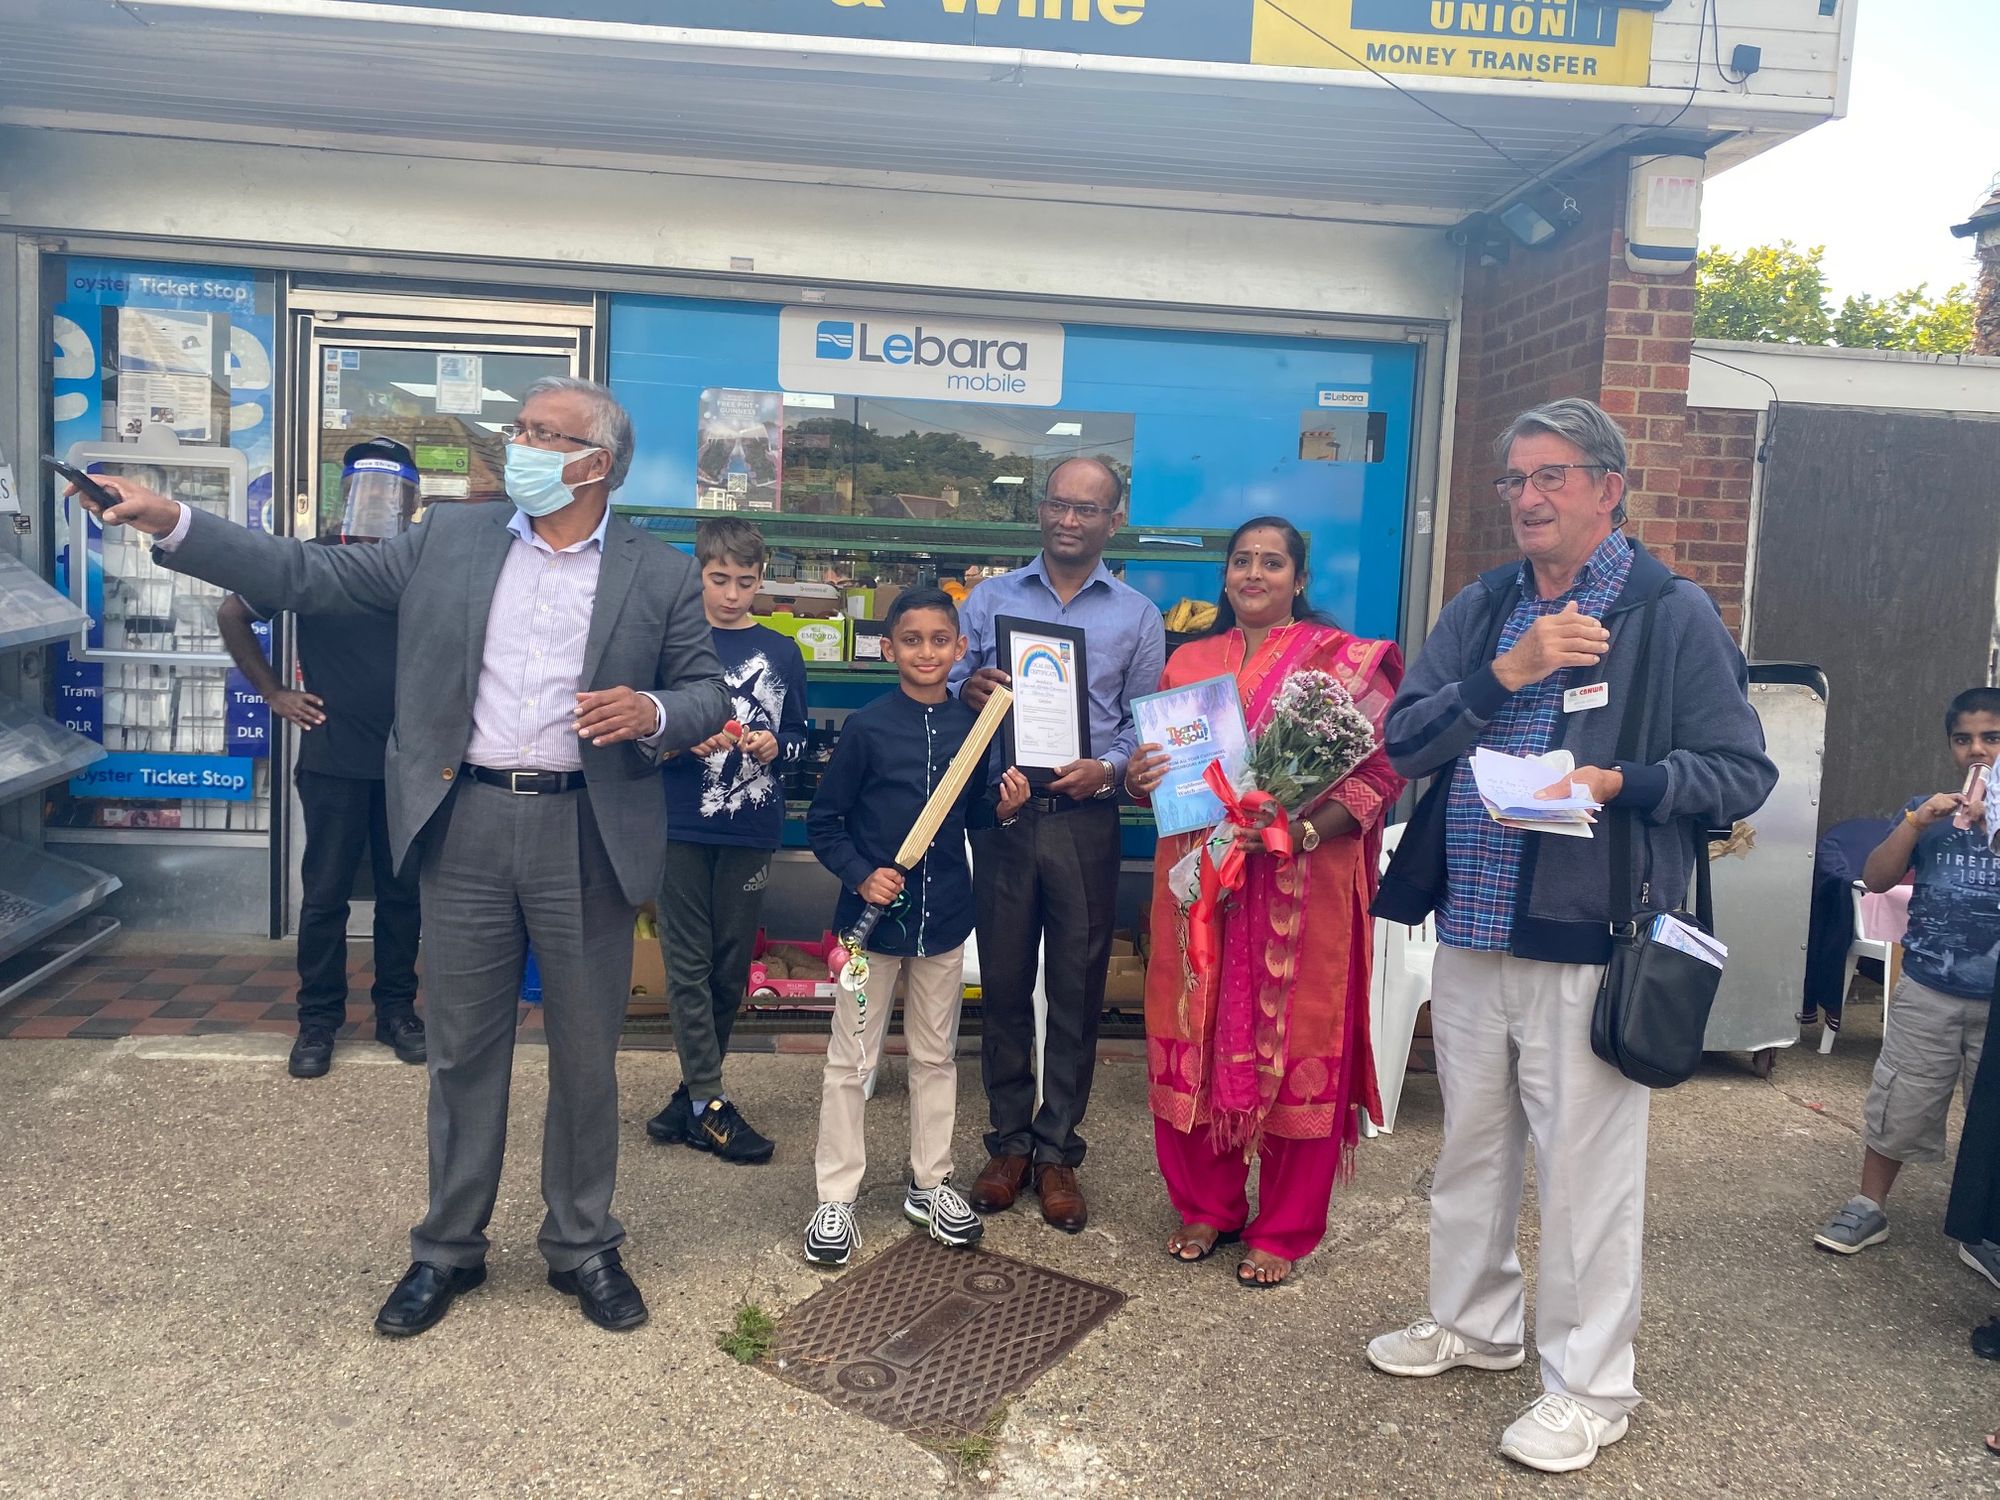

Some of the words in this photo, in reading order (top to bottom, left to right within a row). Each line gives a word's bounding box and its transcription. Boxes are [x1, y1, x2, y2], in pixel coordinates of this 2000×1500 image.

[1430, 1, 1566, 37] UNION
[1366, 43, 1456, 66] MONEY
[1468, 49, 1597, 76] TRANSFER
[74, 276, 130, 294] oyster
[138, 277, 198, 297] Ticket
[203, 282, 247, 301] Stop
[859, 323, 1027, 371] Lebara
[948, 373, 1026, 394] mobile
[1332, 393, 1364, 402] Lebara
[62, 685, 96, 698] Tram
[66, 720, 92, 732] DLR
[237, 727, 264, 738] DLR
[77, 769, 134, 786] oyster
[140, 768, 198, 786] Ticket
[202, 770, 244, 789] Stop
